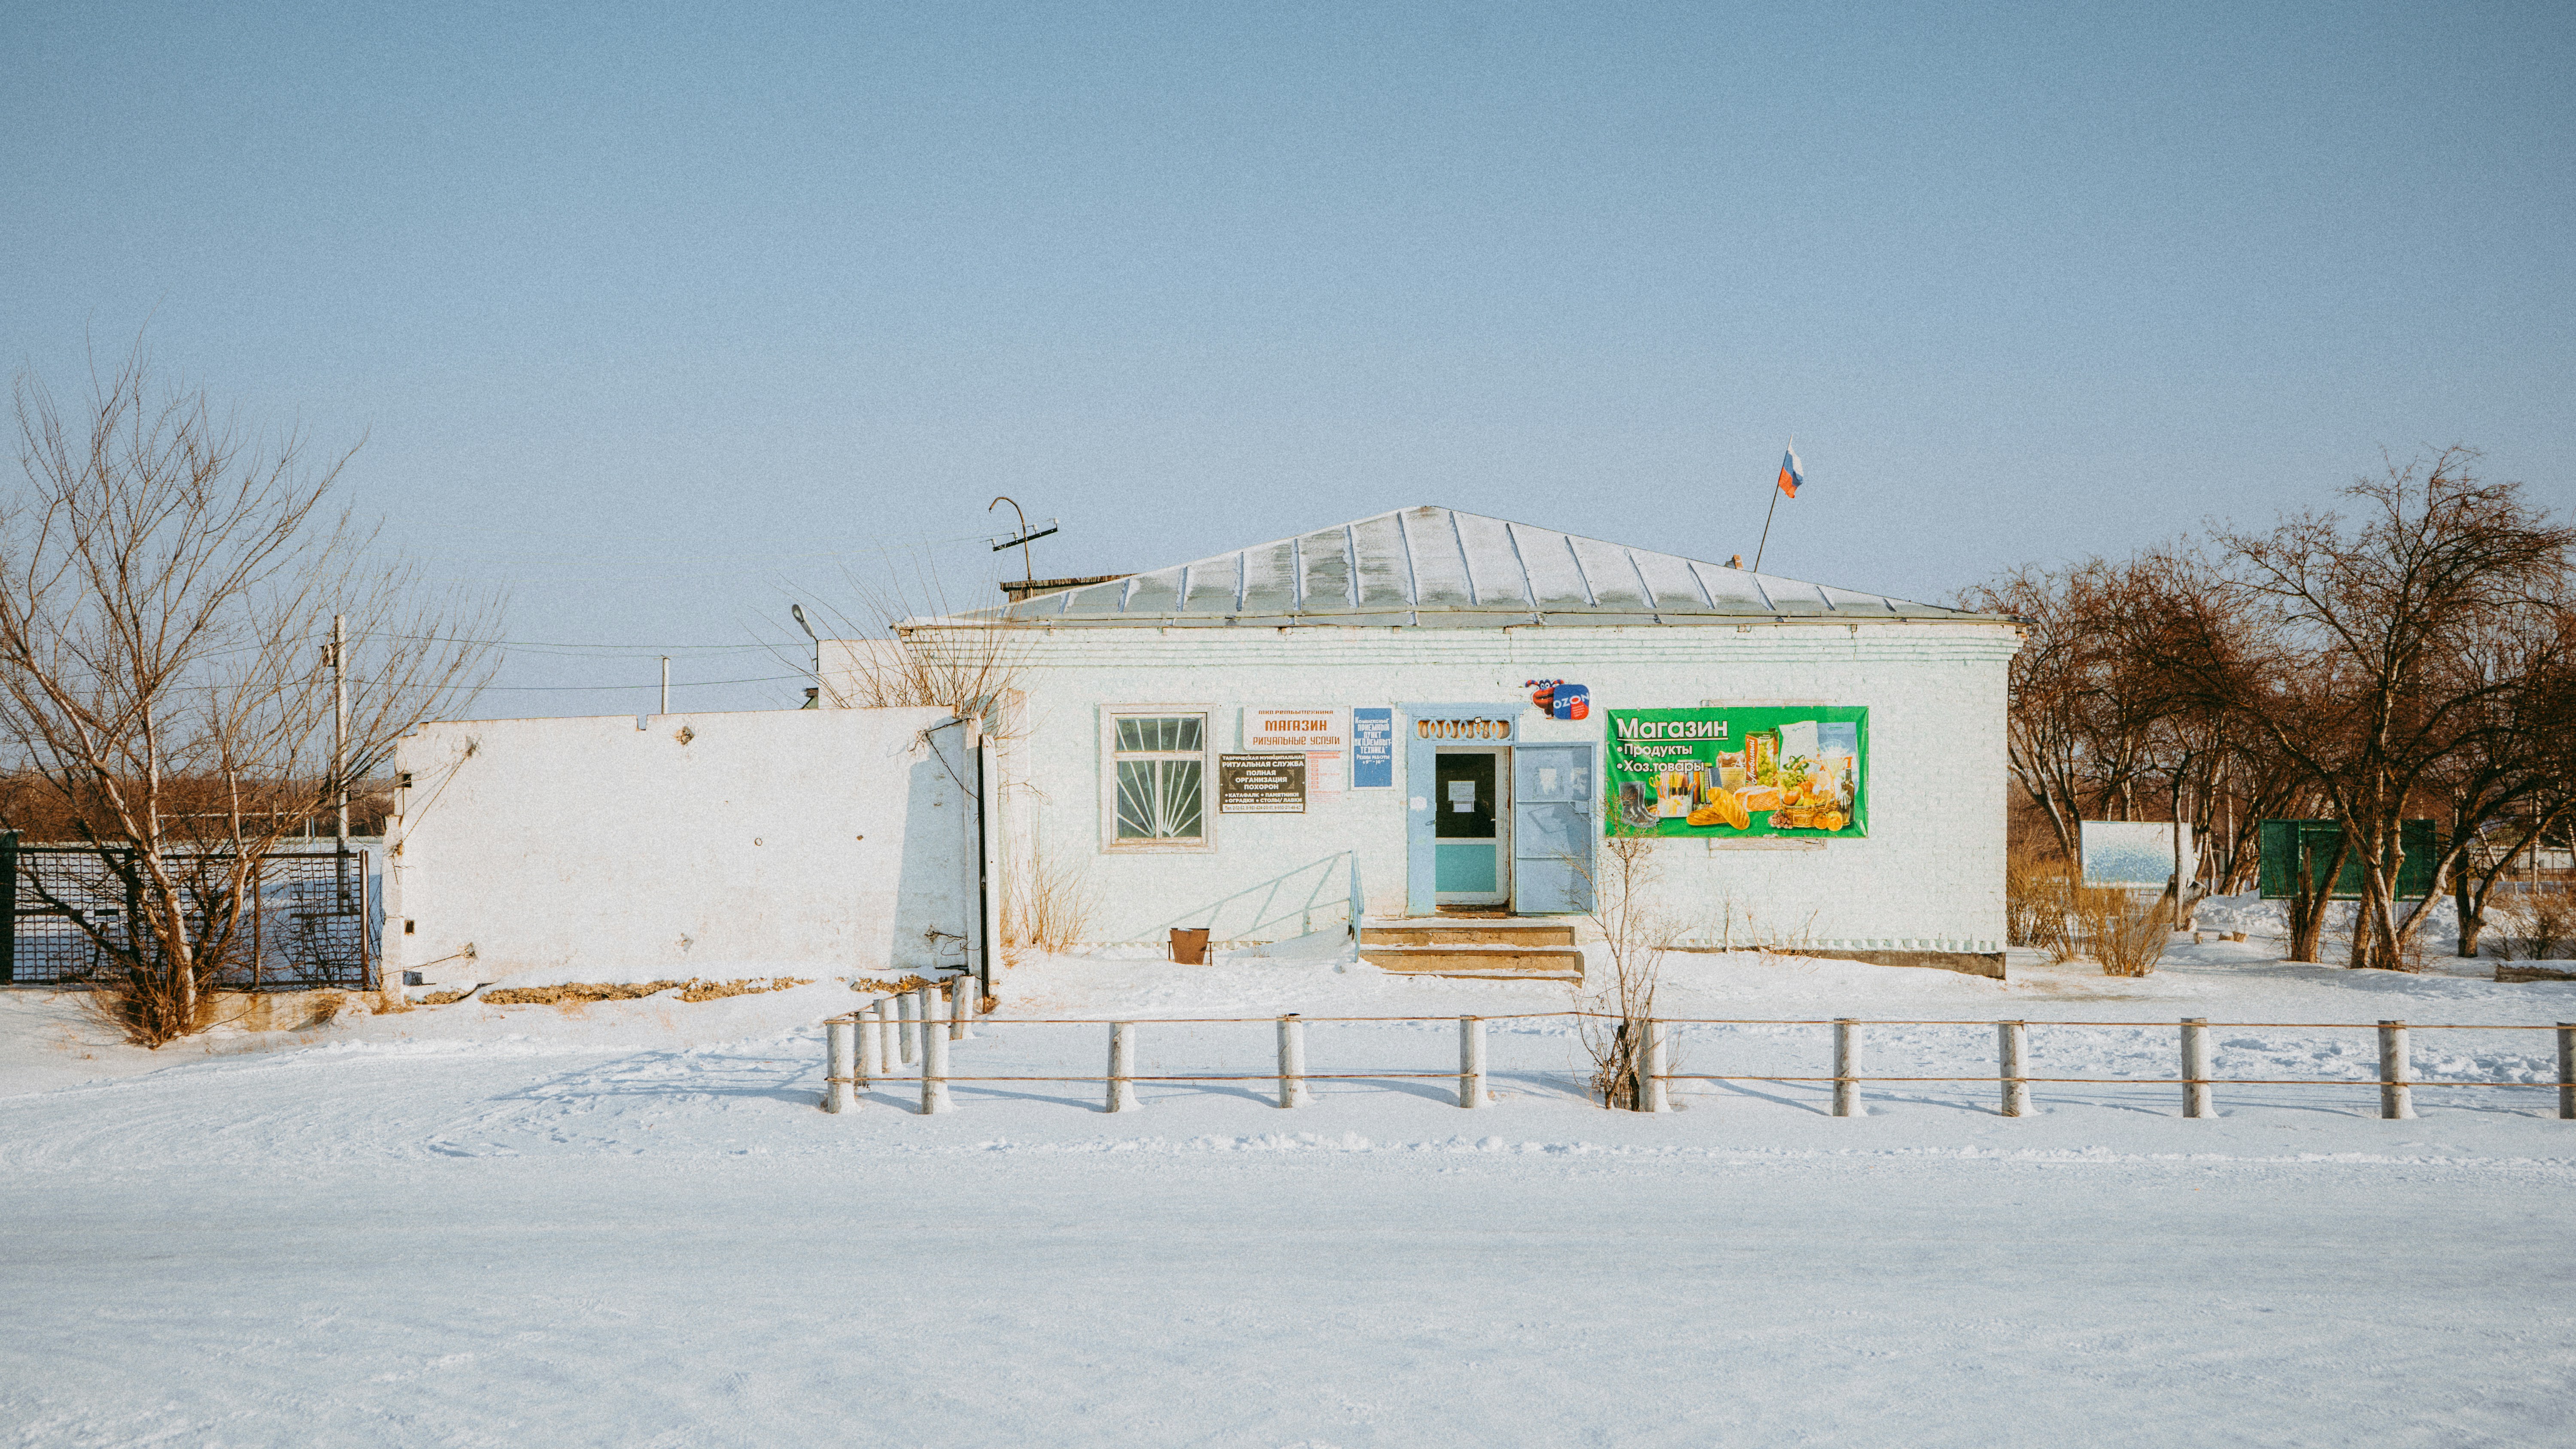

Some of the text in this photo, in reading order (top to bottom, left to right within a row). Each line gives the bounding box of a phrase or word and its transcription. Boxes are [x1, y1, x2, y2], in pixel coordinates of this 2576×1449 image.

[1553, 692, 1589, 709] OZON
[1265, 720, 1327, 731] МАГАЗИН
[1616, 718, 1728, 738] Магазин
[1253, 736, 1340, 745] РИТУАЛЬНЫЕ УСЛУГИ
[1624, 743, 1692, 758] Продукты
[1623, 759, 1704, 774] Хоз.товары
[1747, 738, 1758, 784] Любимый
